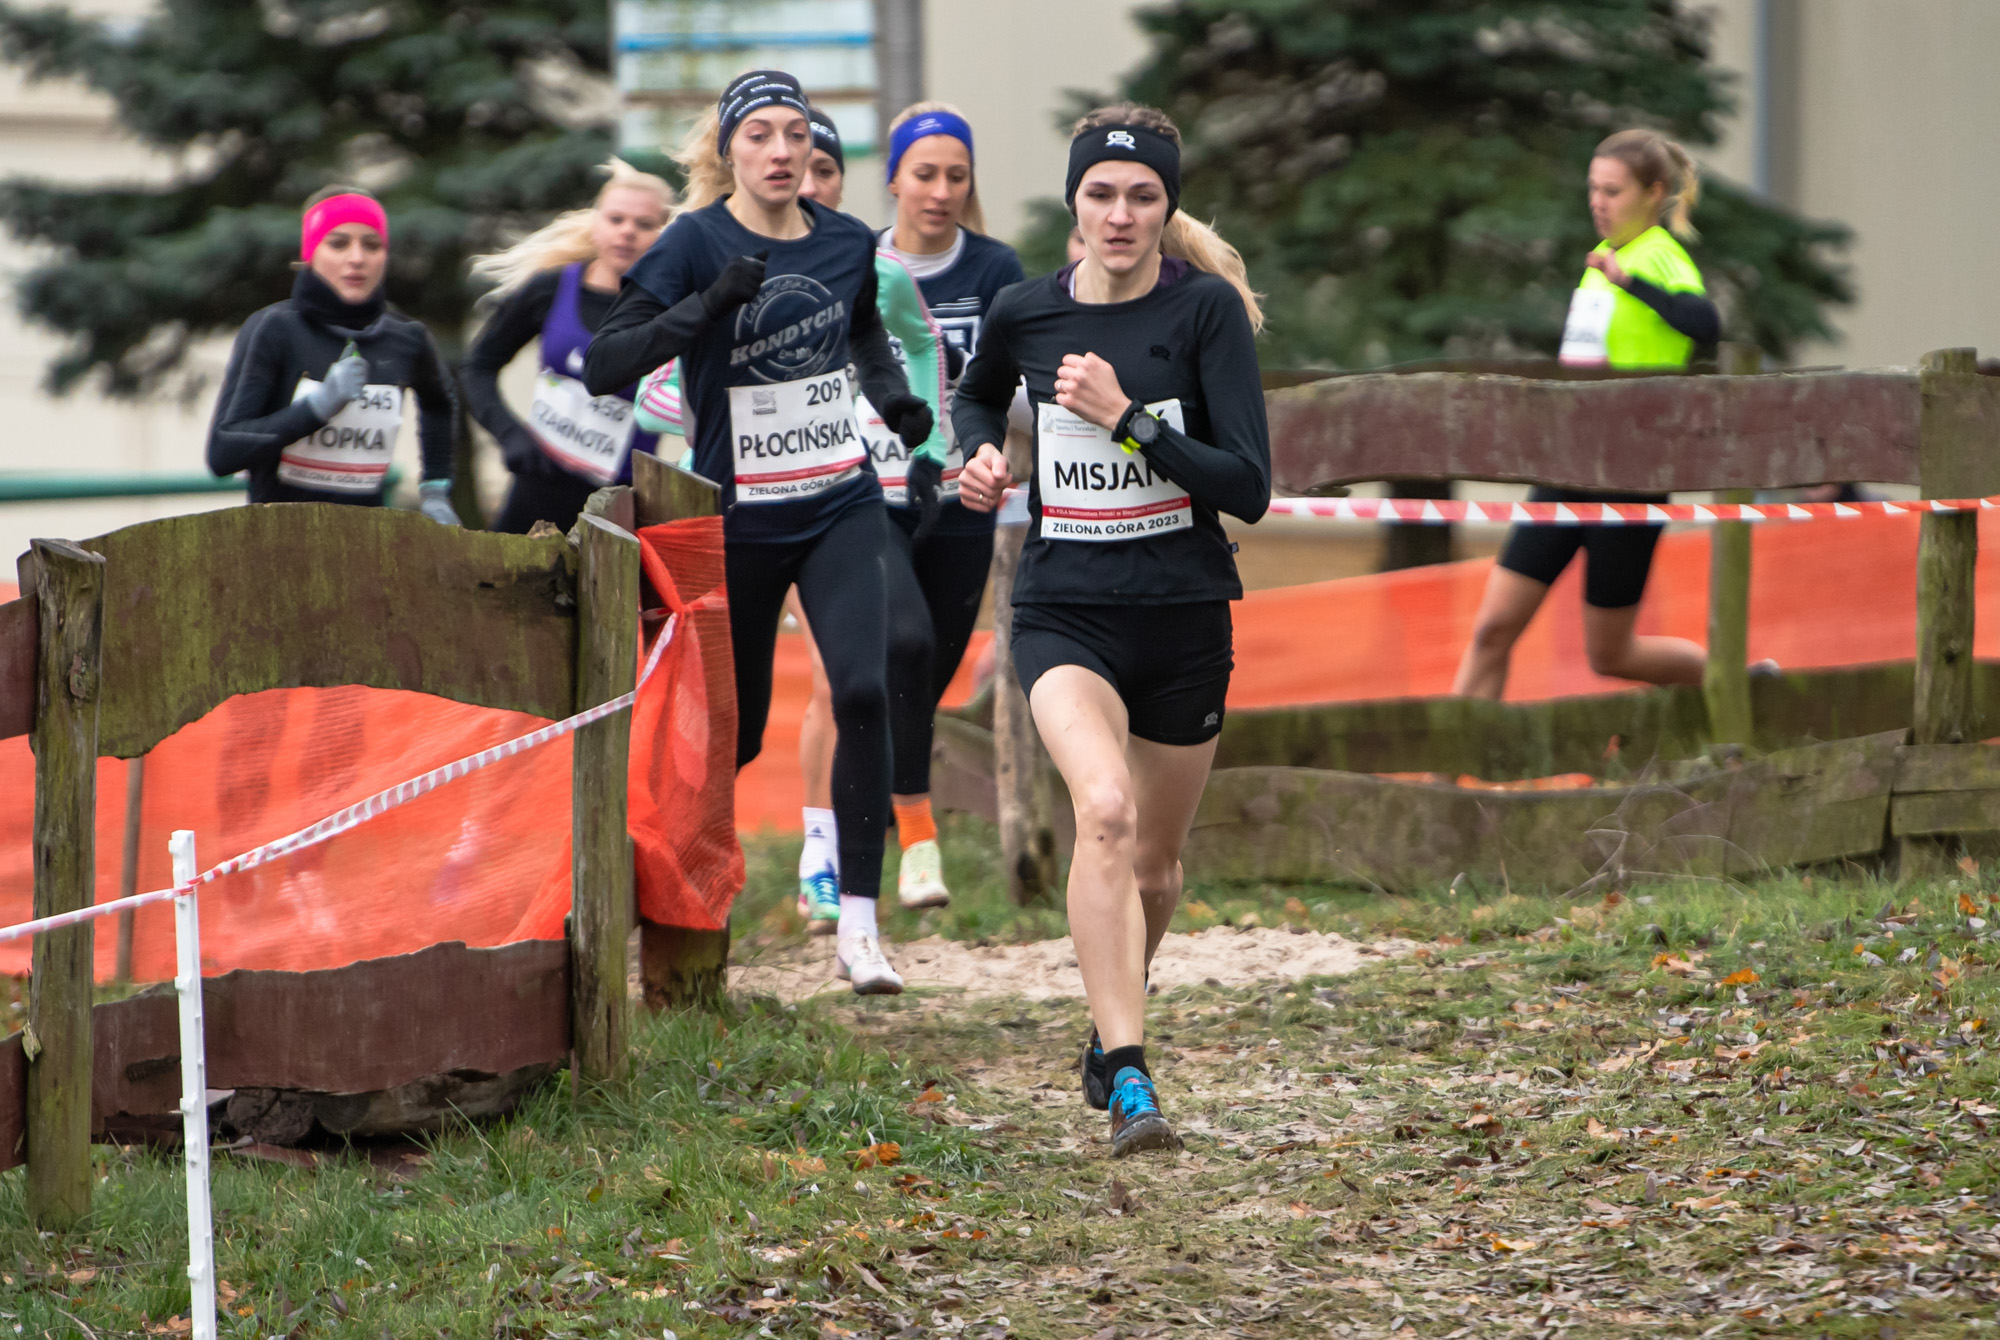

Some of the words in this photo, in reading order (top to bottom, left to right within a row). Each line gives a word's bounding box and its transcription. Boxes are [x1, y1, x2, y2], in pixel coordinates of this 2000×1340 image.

[359, 390, 393, 410] 545
[805, 377, 842, 406] 209
[589, 398, 629, 422] 456
[533, 400, 615, 456] CZARNOTA
[738, 418, 857, 459] PŁOCIŃSKA
[748, 484, 798, 497] ZIELONA
[800, 478, 832, 491] GÓRA
[1053, 522, 1102, 535] ZIELONA
[1105, 521, 1145, 535] GÓRA
[1148, 514, 1179, 530] 2023
